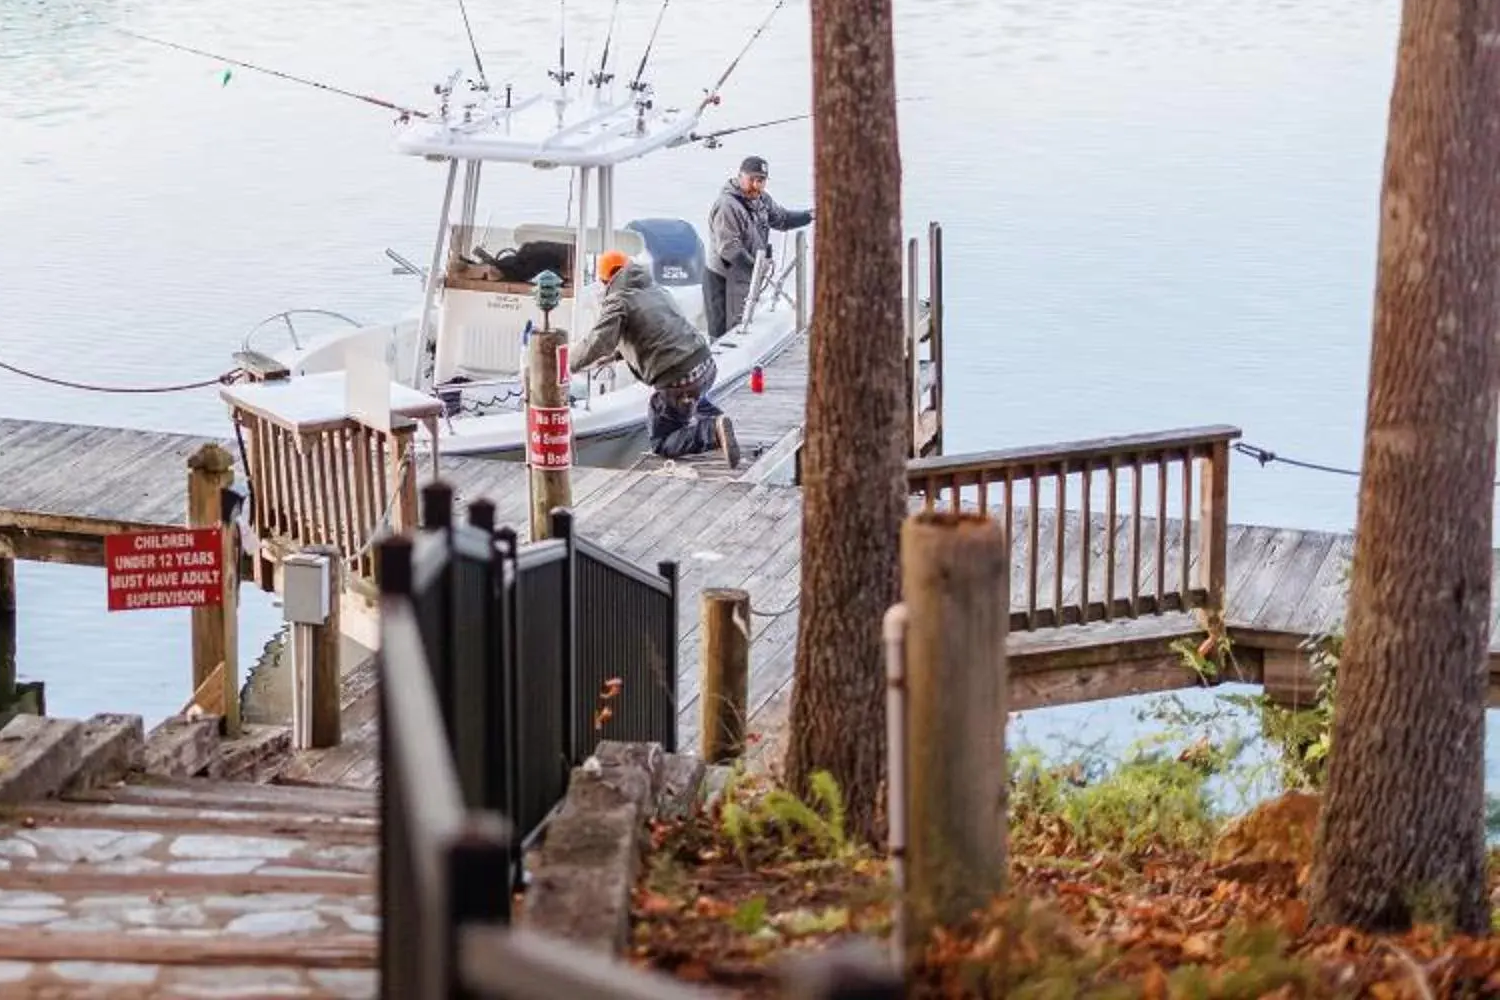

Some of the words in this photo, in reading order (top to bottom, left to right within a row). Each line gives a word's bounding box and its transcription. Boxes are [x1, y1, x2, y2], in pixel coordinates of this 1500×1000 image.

[134, 534, 194, 549] CHILDREN
[115, 555, 155, 569] UNDER
[159, 555, 173, 567] 12
[175, 552, 215, 566] YEARS
[111, 574, 144, 589] MUST
[148, 572, 178, 586] HAVE
[182, 570, 220, 584] ADULT
[126, 590, 205, 606] SUPERVISION
